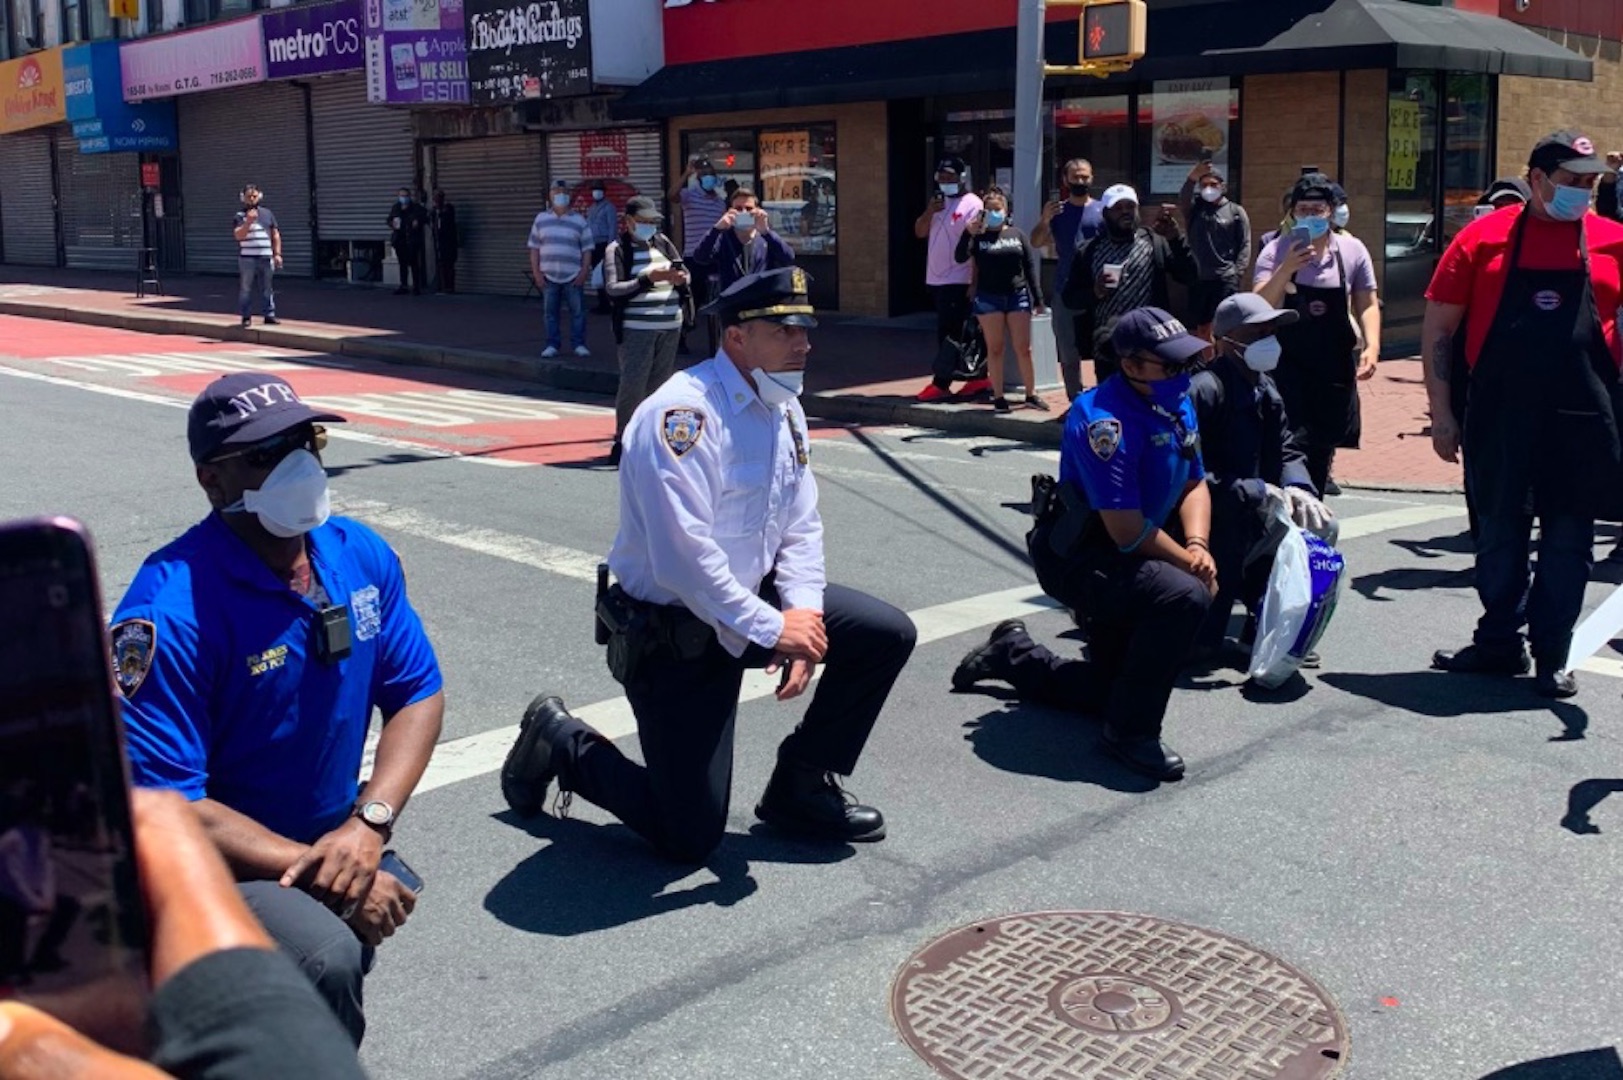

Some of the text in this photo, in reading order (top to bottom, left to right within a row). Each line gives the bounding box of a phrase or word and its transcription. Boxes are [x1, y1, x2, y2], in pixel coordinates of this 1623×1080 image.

[268, 18, 359, 63] metroPCS
[430, 37, 467, 57] Apple
[420, 62, 438, 80] WE
[439, 60, 464, 79] SELL
[421, 81, 467, 101] GSM
[114, 136, 137, 147] NOW
[138, 136, 169, 147] HIRING
